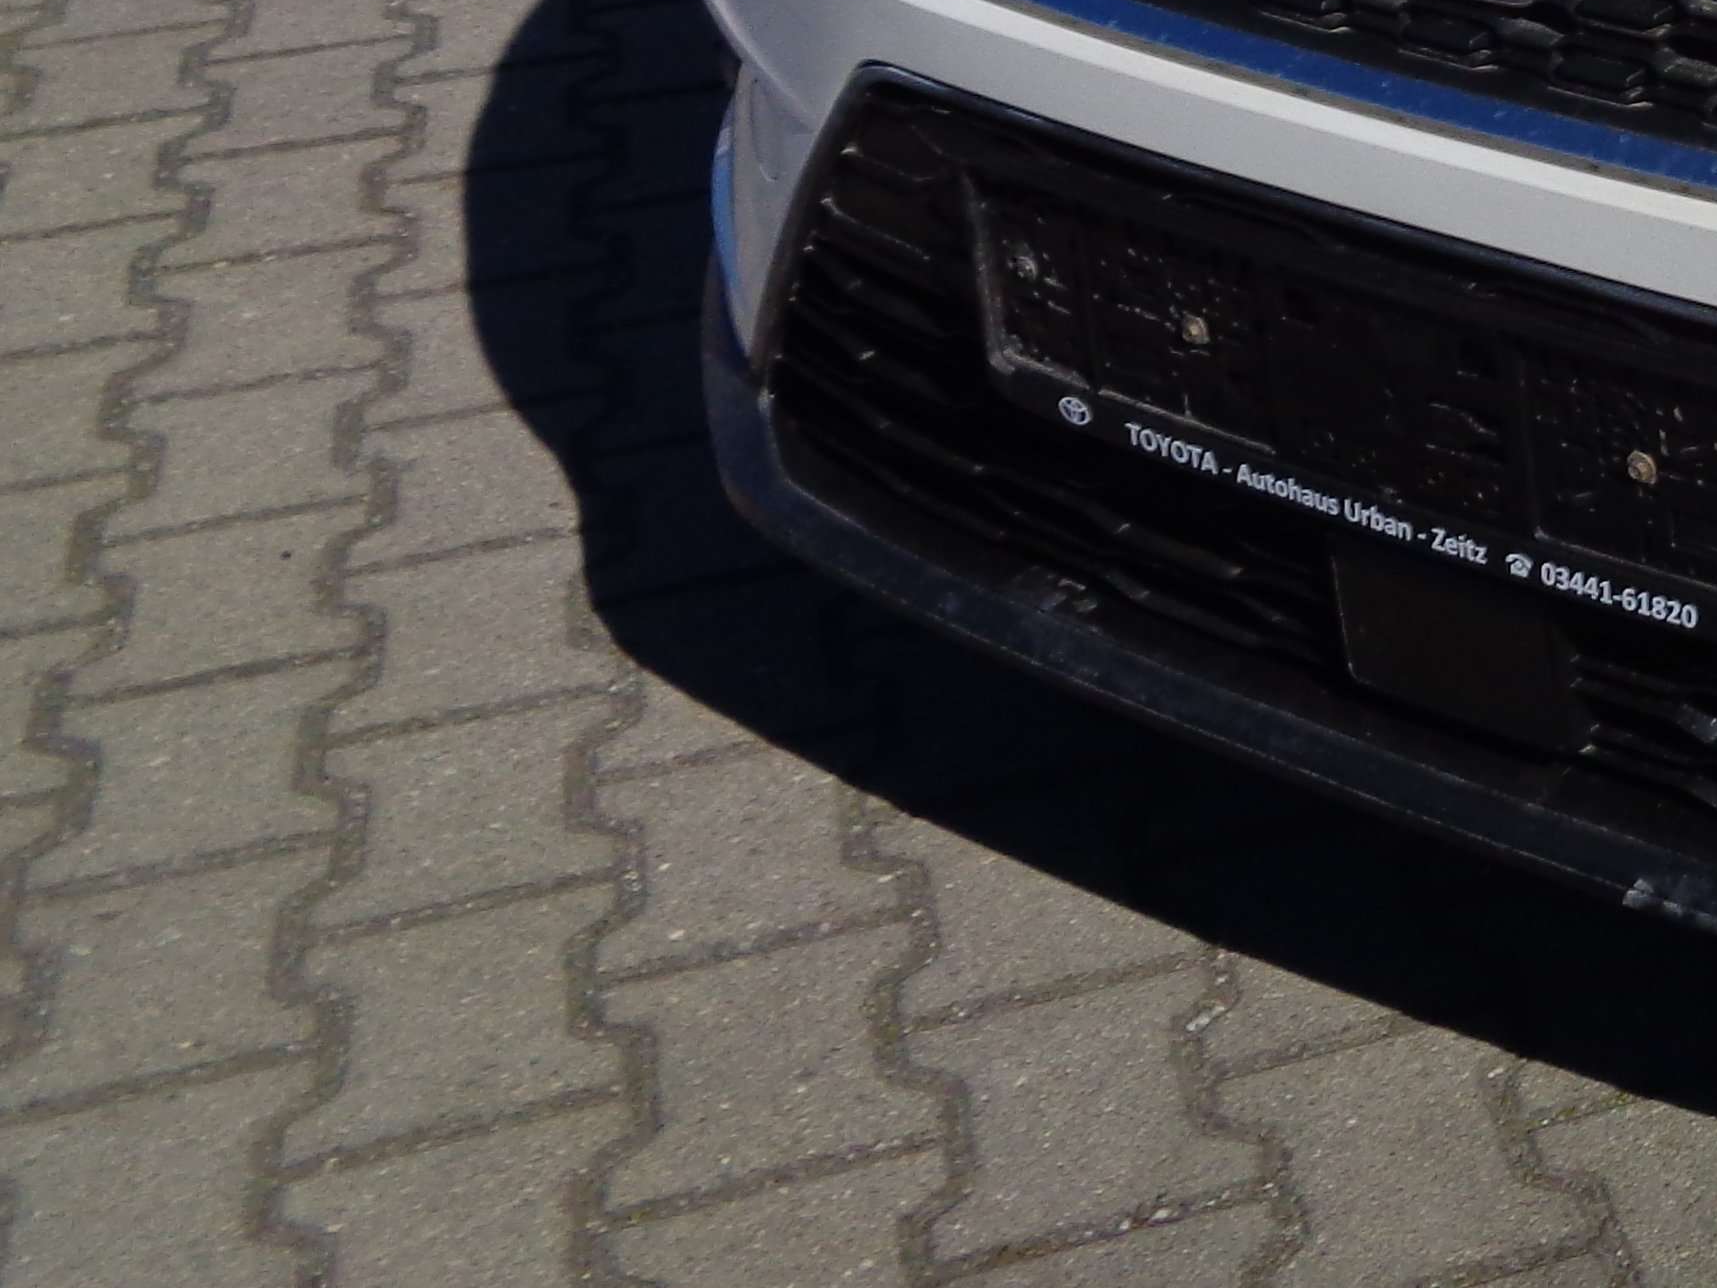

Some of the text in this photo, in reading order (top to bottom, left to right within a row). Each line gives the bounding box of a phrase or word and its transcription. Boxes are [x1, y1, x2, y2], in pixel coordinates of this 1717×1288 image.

[1125, 422, 1219, 475] TOYOTA
[1236, 463, 1339, 517] Autohaus
[1343, 498, 1413, 542] Urban
[1430, 528, 1488, 565] Zeitz
[1540, 562, 1698, 630] 03441-61820
